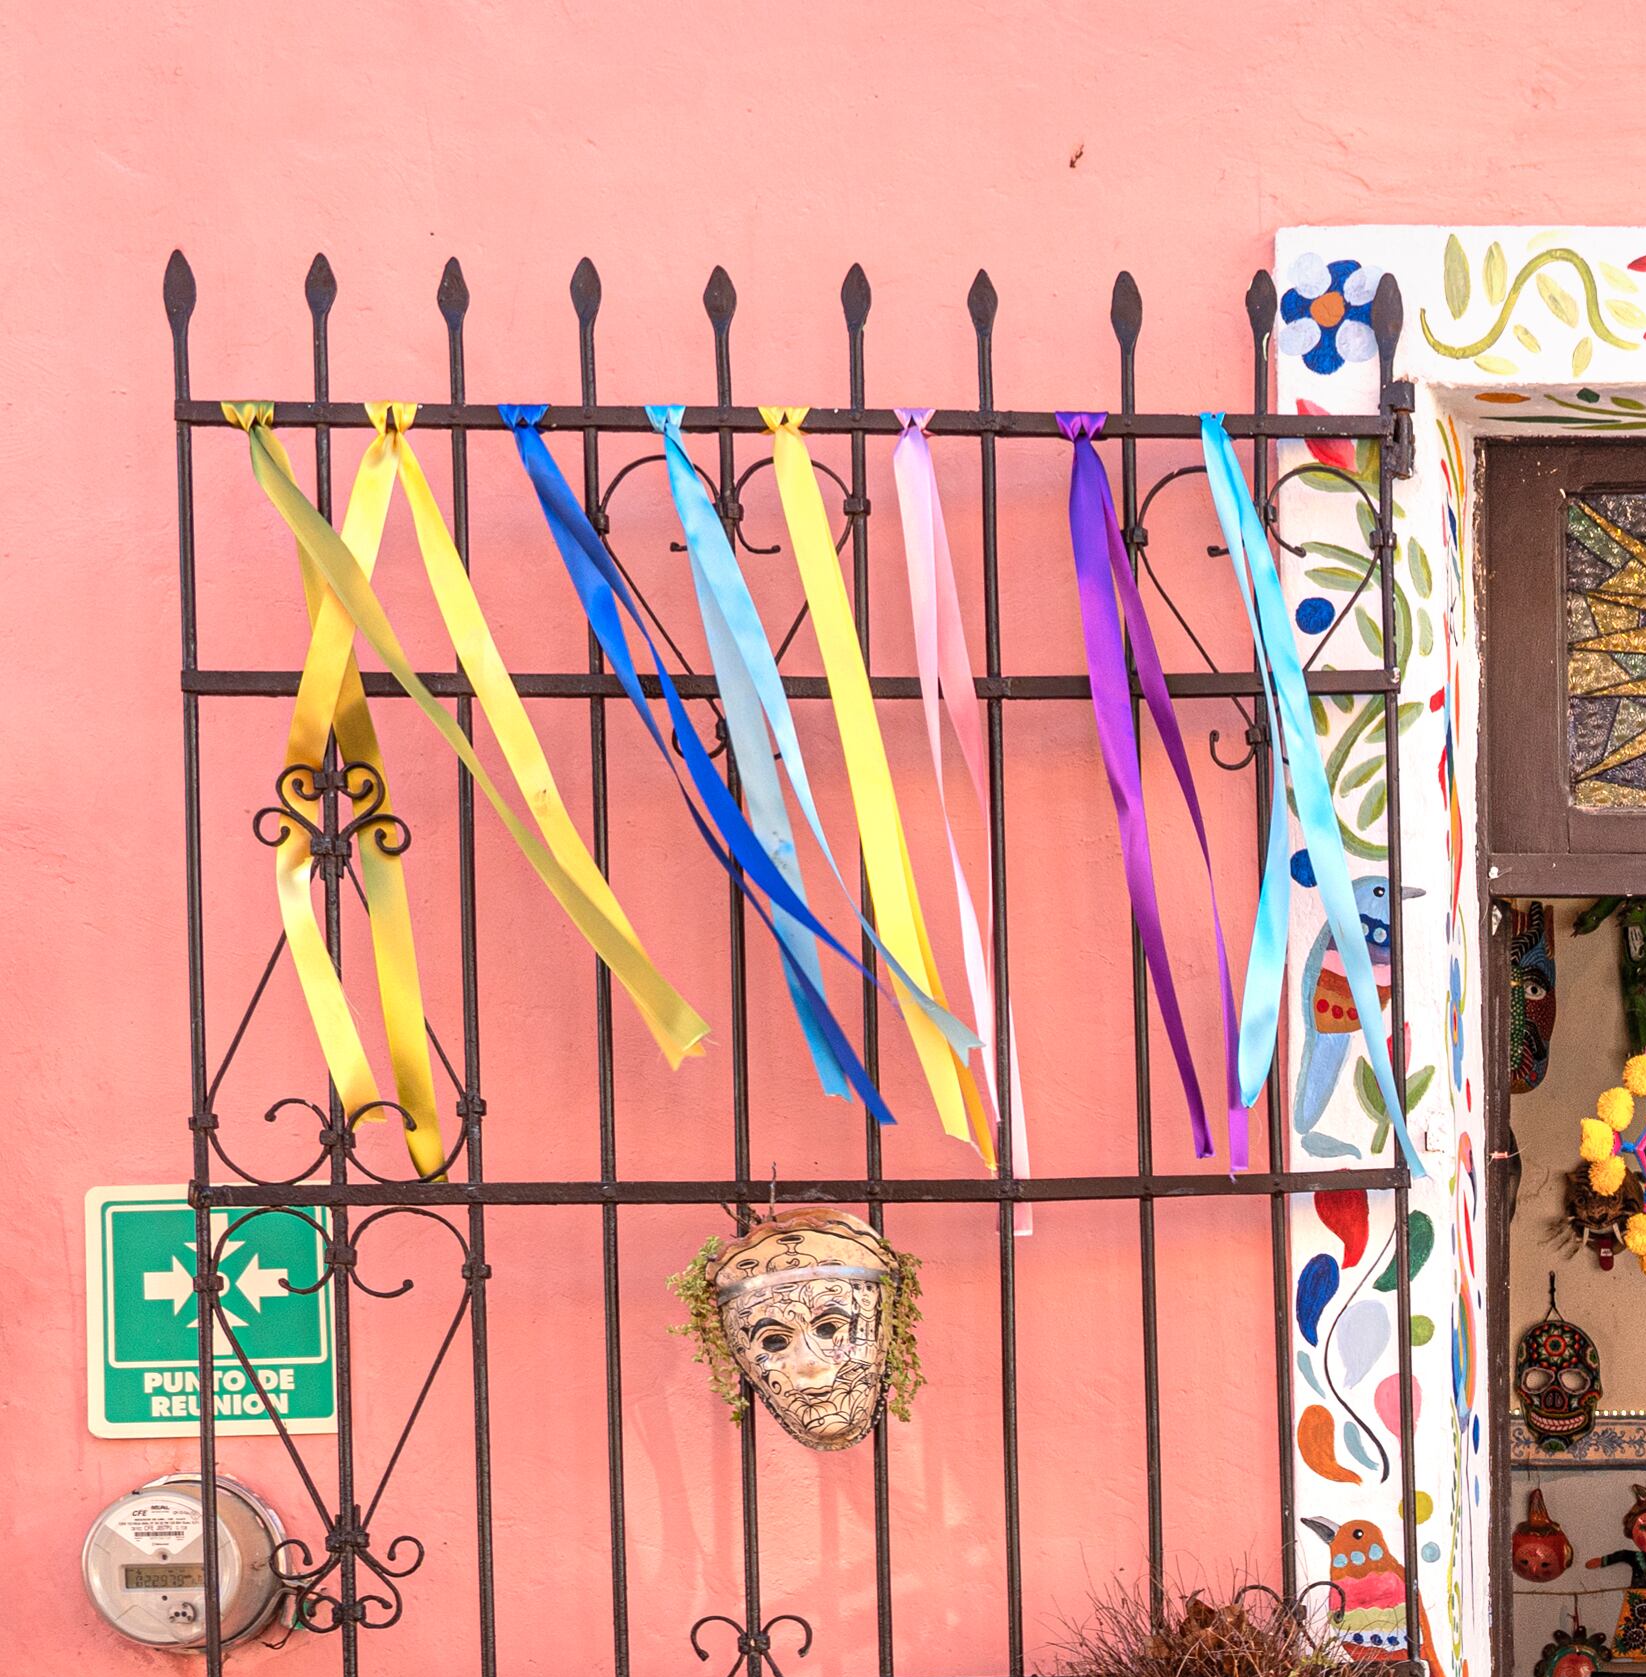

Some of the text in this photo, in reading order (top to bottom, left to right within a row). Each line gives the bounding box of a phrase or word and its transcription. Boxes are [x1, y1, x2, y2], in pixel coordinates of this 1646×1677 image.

[144, 1369, 295, 1393] PUNTO DE
[151, 1393, 288, 1417] REUNION
